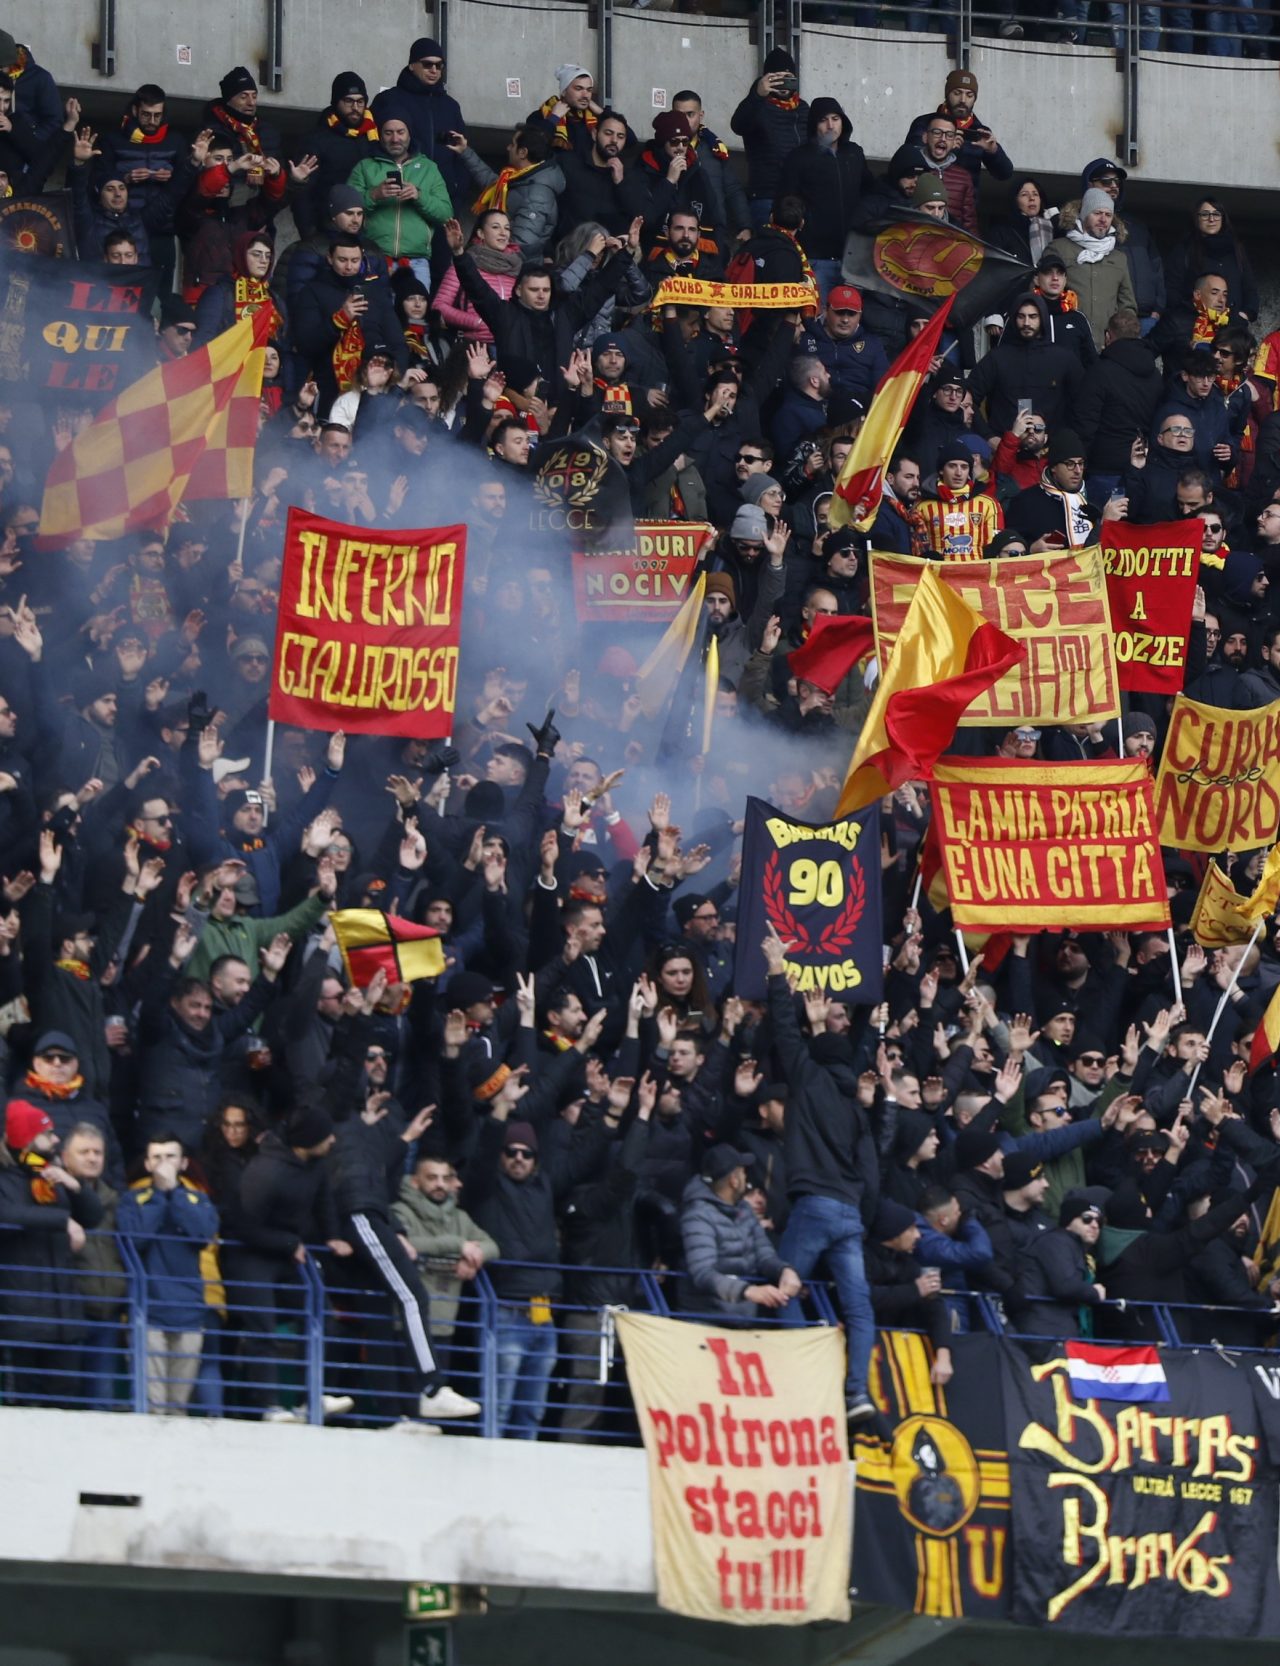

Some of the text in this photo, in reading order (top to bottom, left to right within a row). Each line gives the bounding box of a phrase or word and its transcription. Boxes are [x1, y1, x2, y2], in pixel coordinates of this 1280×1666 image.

[65, 281, 144, 313] LE
[43, 321, 130, 353] QUI
[528, 509, 596, 531] LECCE
[296, 531, 457, 626] INFERNO
[1129, 591, 1148, 620] A
[279, 632, 459, 714] GIALLOROSSO
[1111, 631, 1185, 667] OZZE
[1051, 786, 1152, 841] PATRIA
[1155, 771, 1280, 847] NORD
[789, 858, 844, 907] 90
[648, 1403, 842, 1468] poltrona
[685, 1475, 822, 1540] stacci
[1181, 1484, 1223, 1503] LECCE
